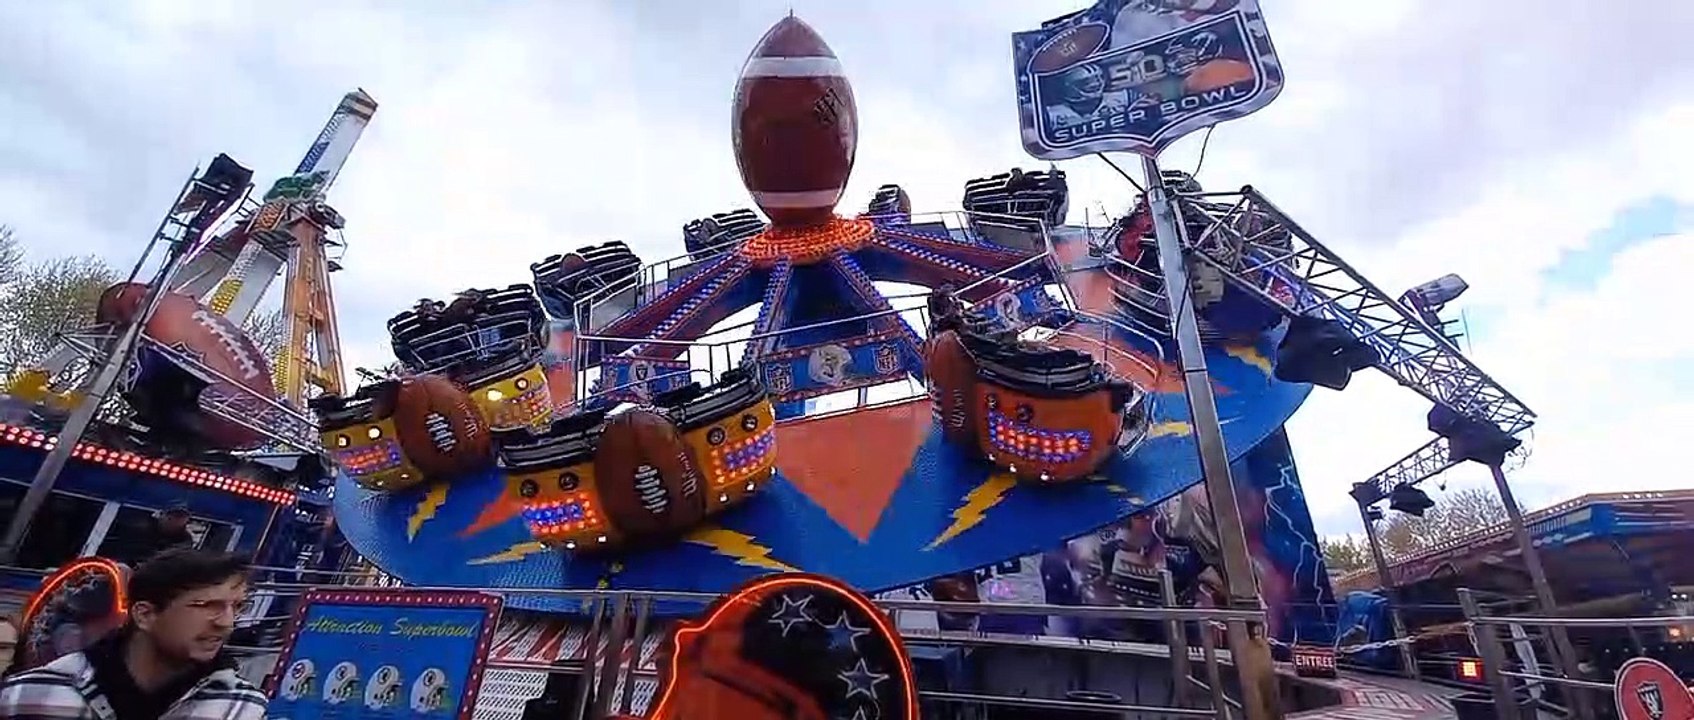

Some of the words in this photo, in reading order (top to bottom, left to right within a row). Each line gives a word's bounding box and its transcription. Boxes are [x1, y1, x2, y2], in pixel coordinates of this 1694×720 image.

[1053, 109, 1148, 143] SUPER
[1159, 85, 1249, 117] BOWL
[301, 615, 383, 636] Attraction
[389, 616, 479, 641] Superbowl
[1295, 654, 1334, 669] ENTREE
